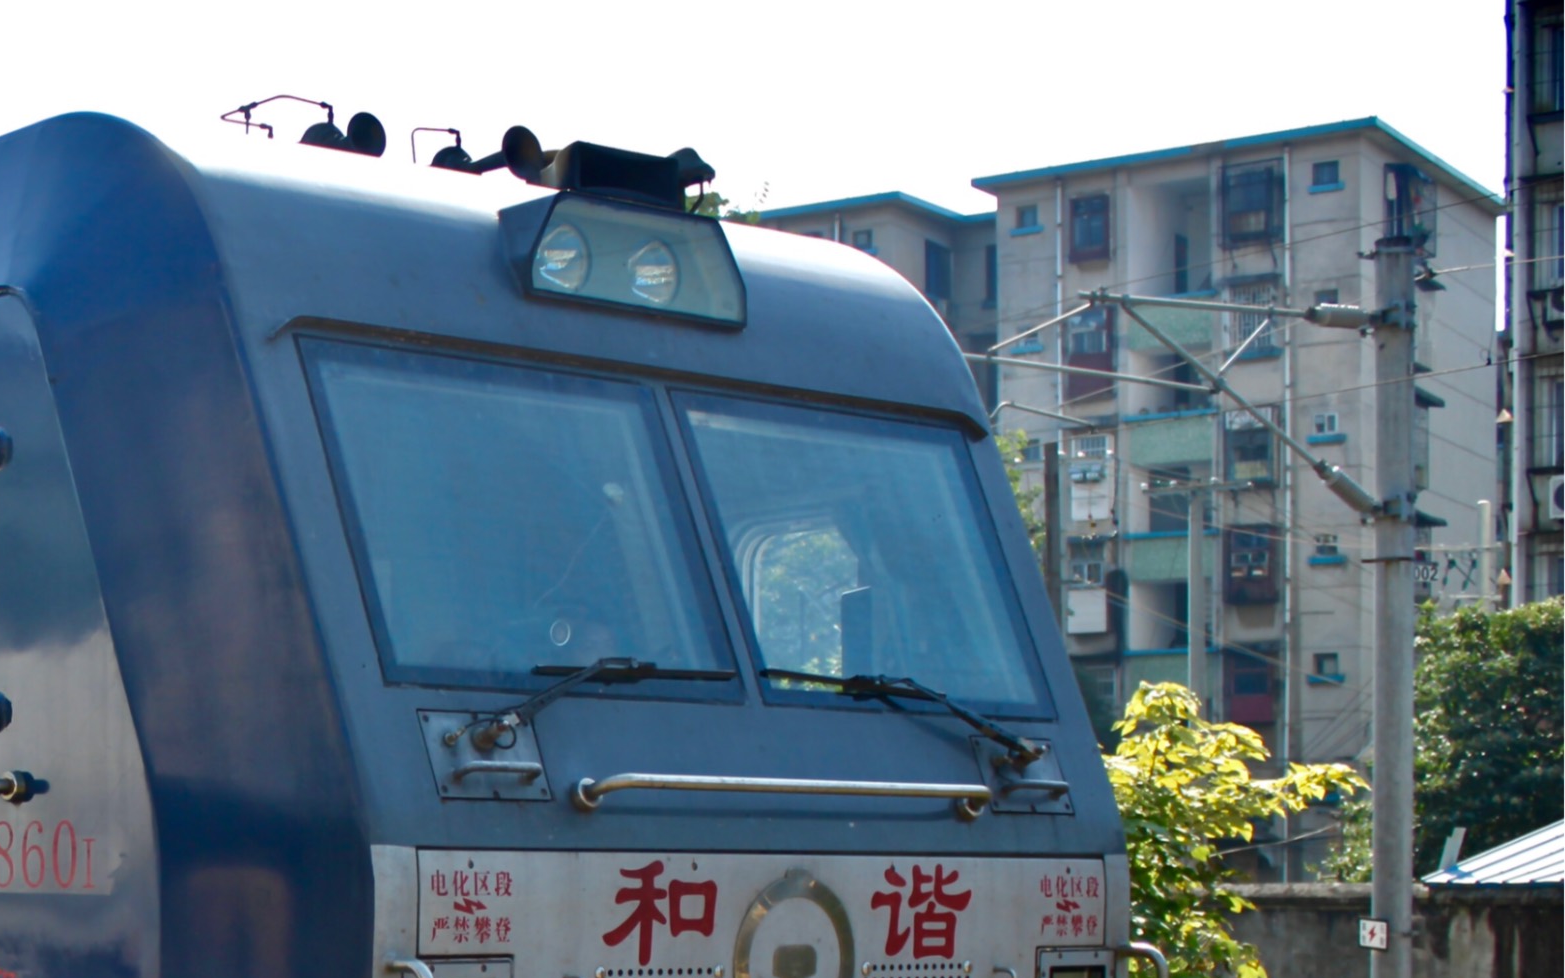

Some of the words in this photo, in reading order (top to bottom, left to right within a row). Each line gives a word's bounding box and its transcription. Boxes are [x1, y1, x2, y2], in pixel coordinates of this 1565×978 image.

[431, 869, 512, 896] 电化区段
[1040, 874, 1099, 898] 电化区段
[602, 860, 718, 966] 和
[871, 864, 972, 960] 谐
[431, 916, 511, 944] 严禁攀登
